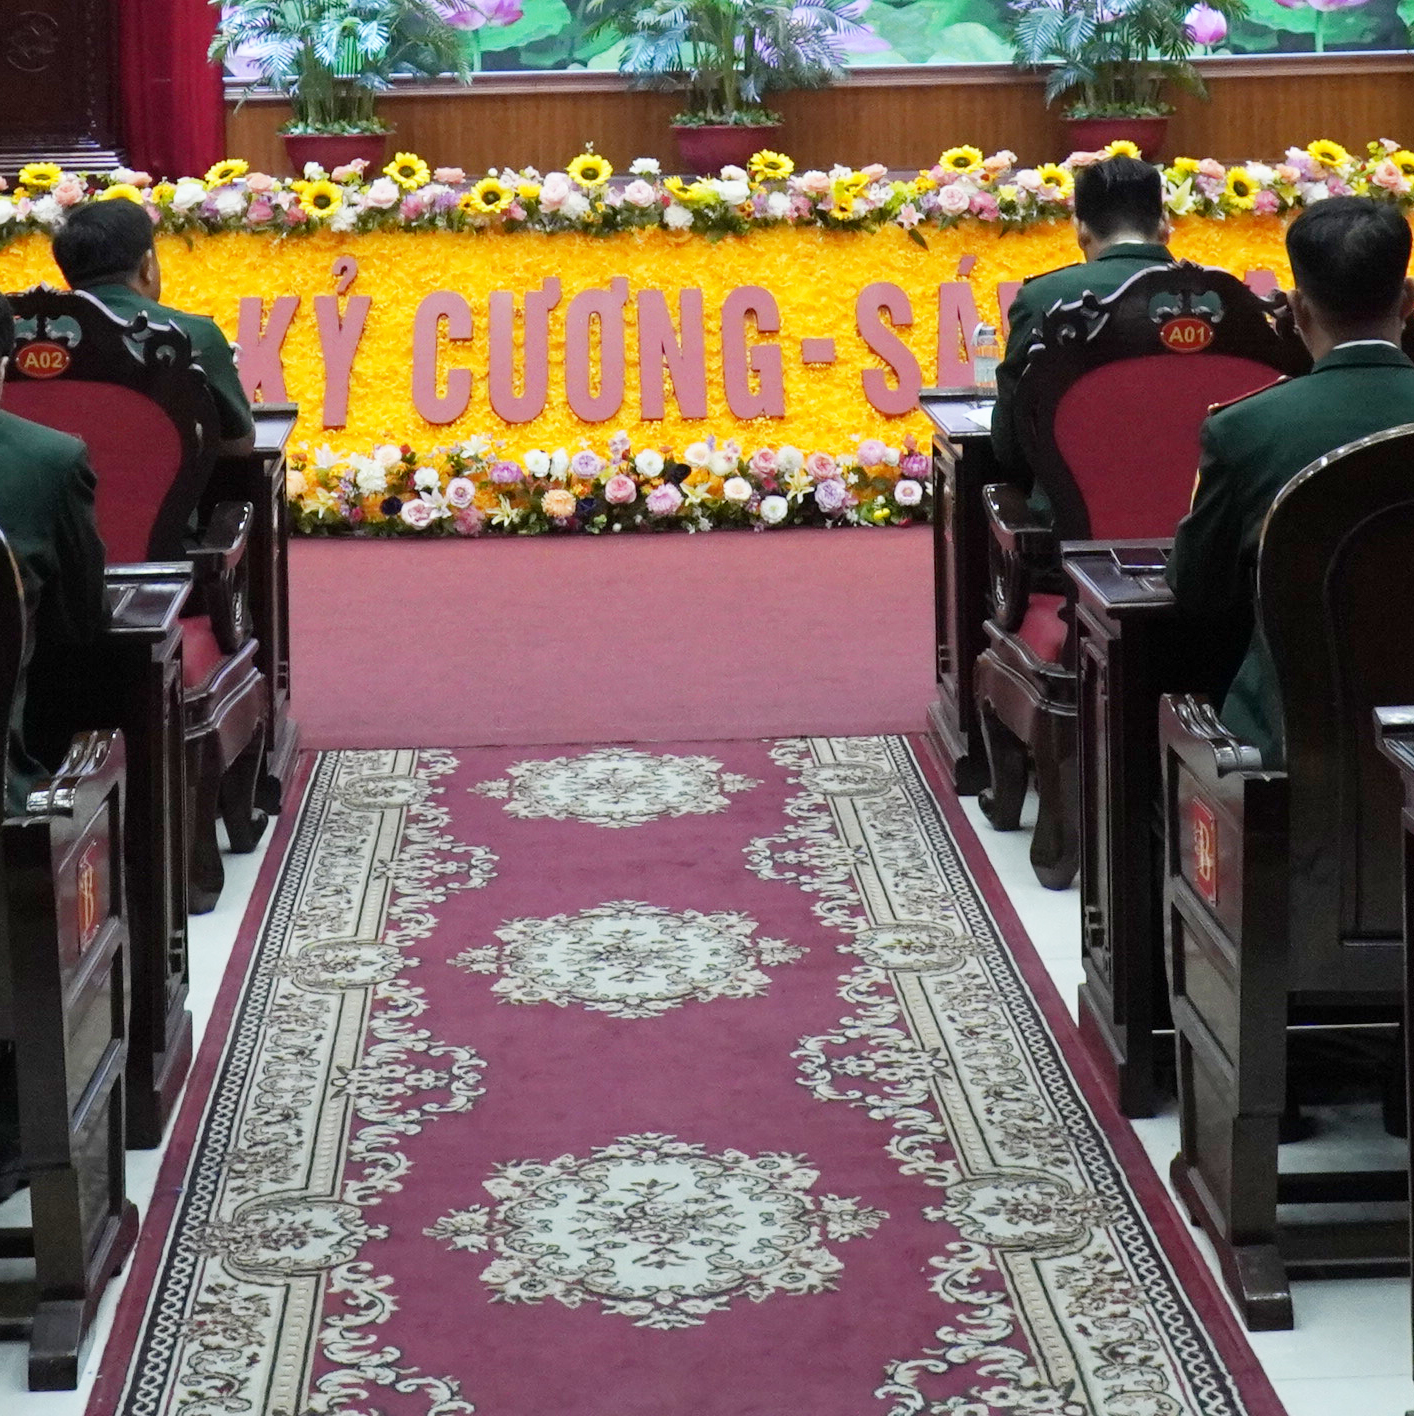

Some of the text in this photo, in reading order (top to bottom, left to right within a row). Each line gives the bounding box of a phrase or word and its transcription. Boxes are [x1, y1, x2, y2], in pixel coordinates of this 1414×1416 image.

[237, 255, 373, 429] KỶ
[1168, 325, 1206, 343] A01
[23, 351, 63, 369] A02
